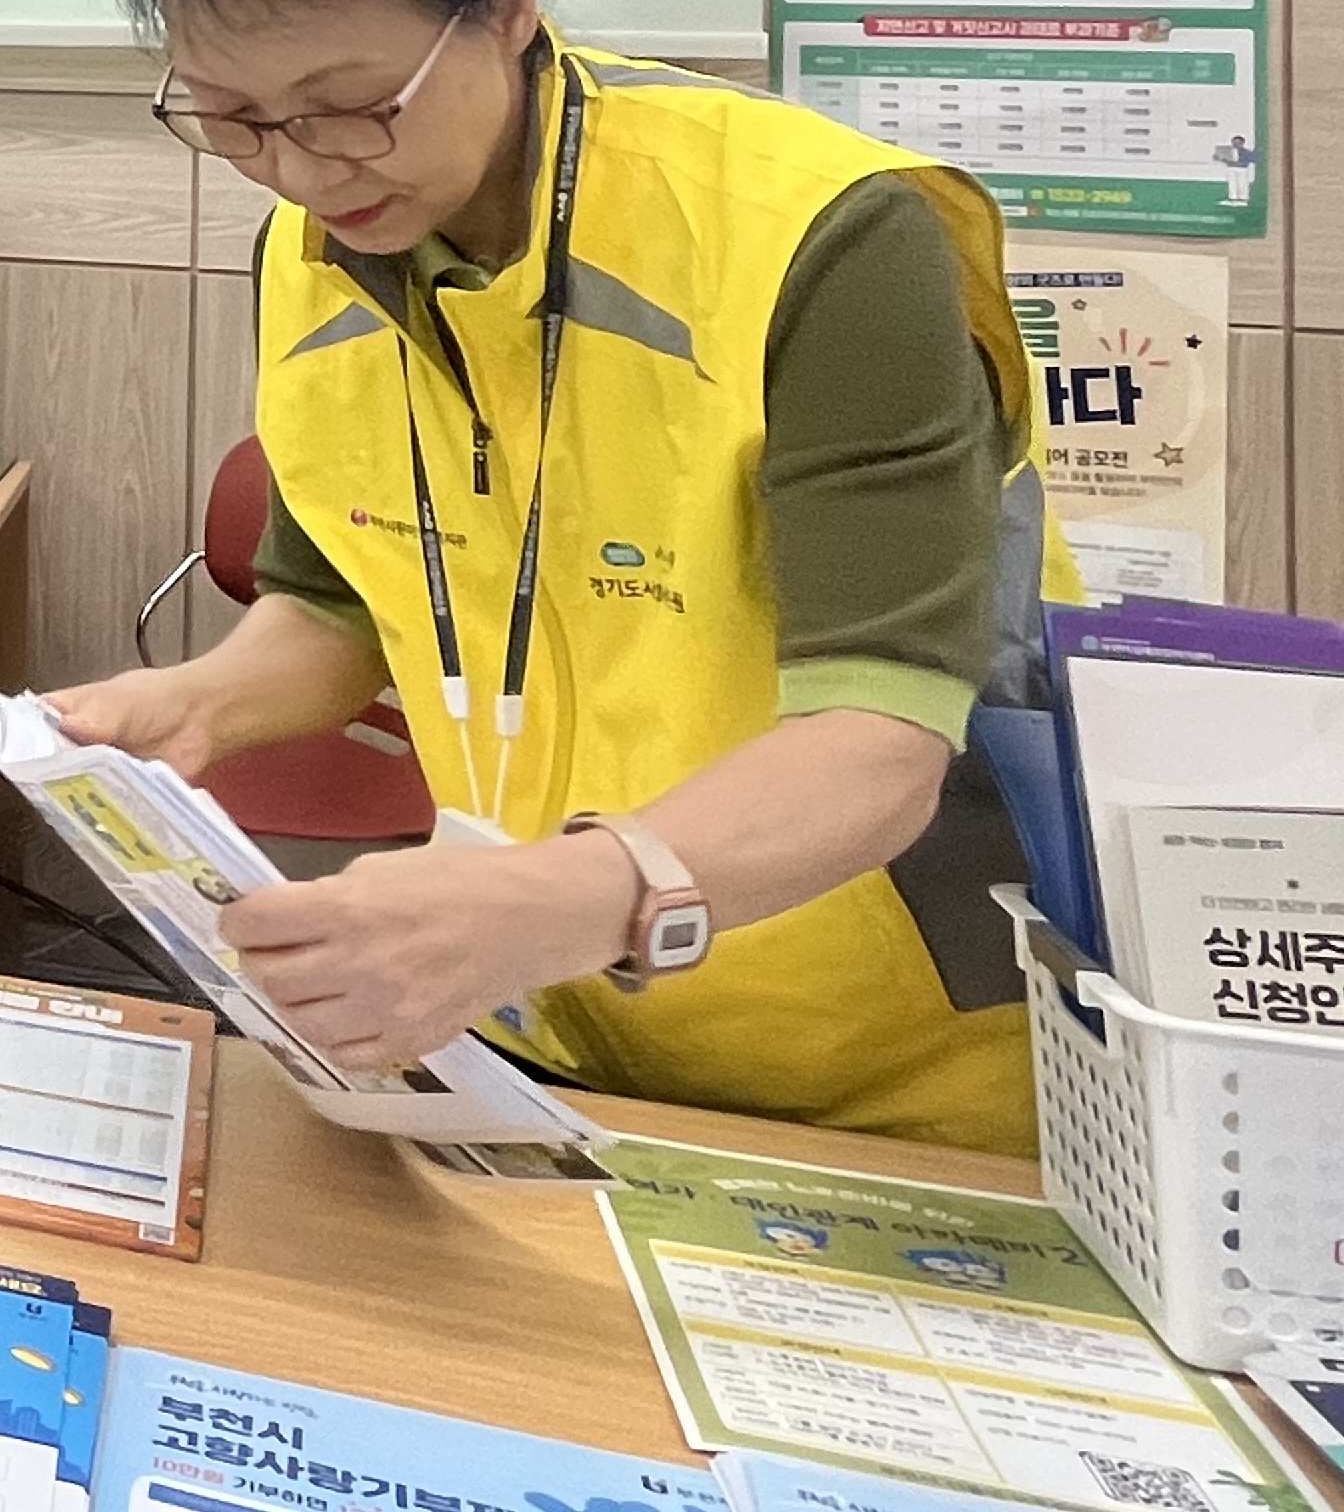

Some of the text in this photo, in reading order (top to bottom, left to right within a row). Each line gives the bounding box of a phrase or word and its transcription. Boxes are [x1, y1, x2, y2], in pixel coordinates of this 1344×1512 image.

[1047, 448, 1128, 468] 어 공모전
[157, 1395, 304, 1451] 부천시
